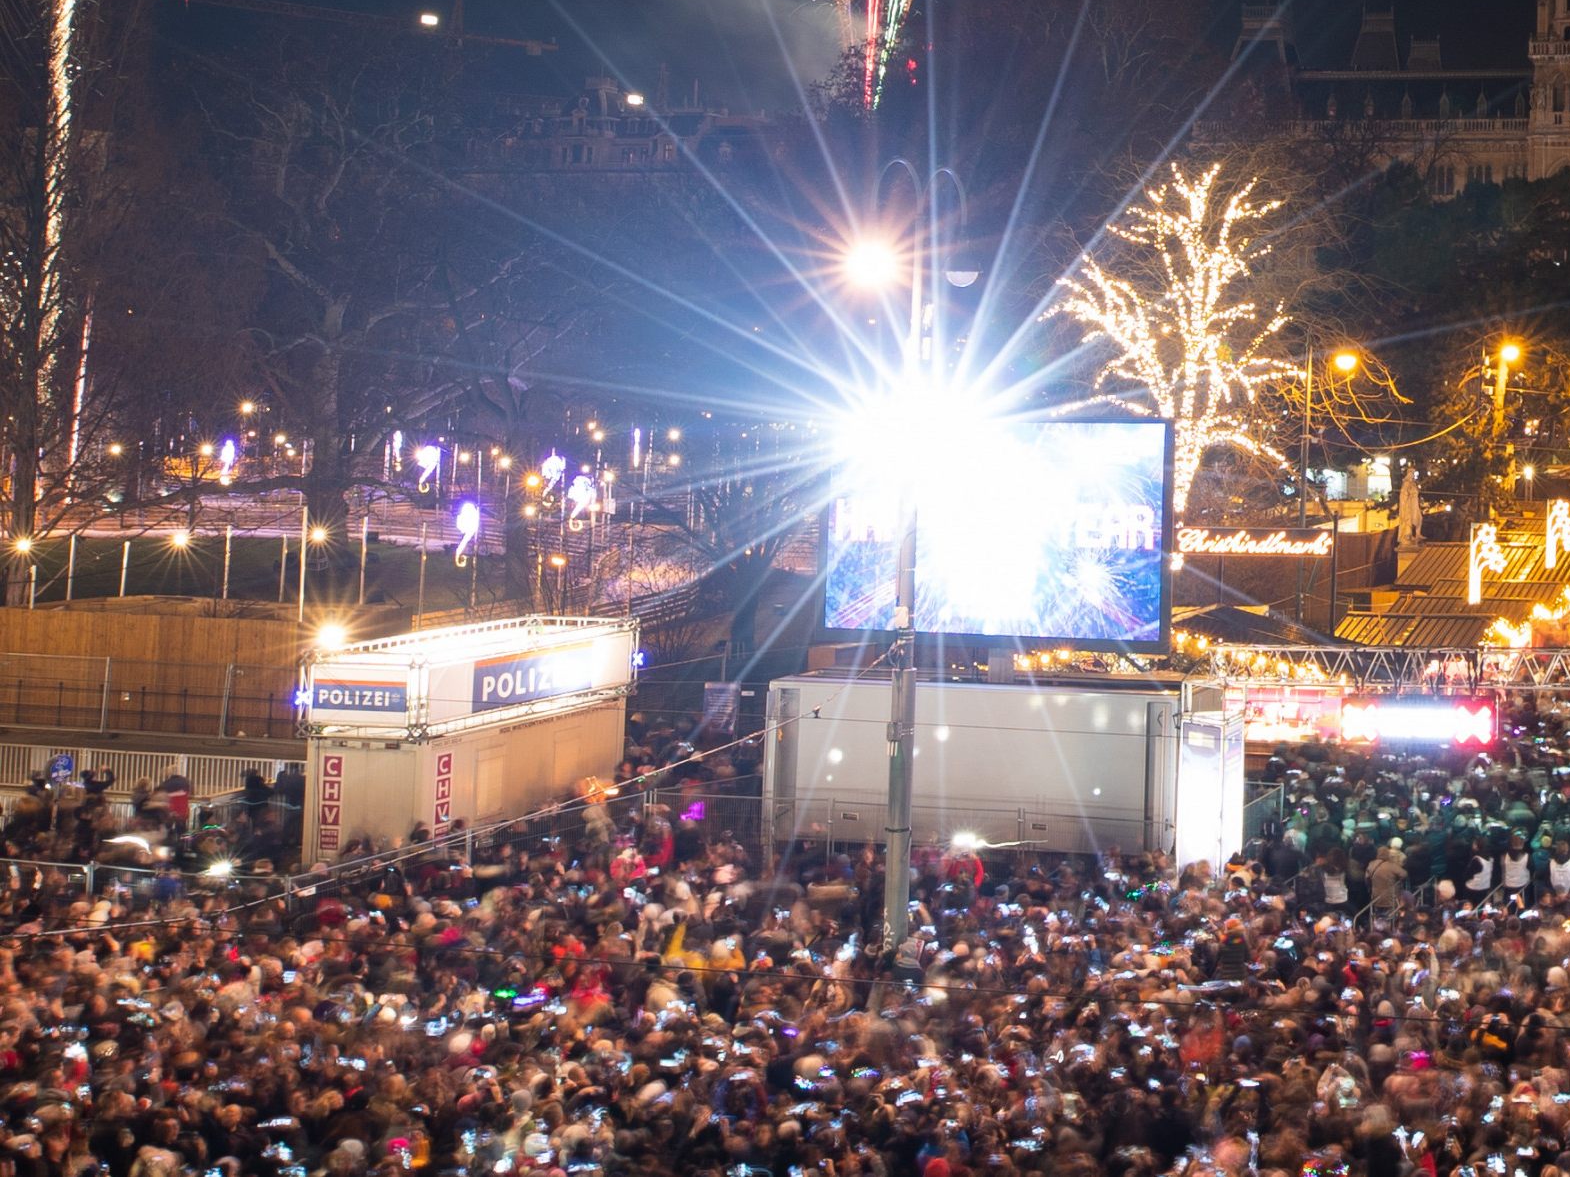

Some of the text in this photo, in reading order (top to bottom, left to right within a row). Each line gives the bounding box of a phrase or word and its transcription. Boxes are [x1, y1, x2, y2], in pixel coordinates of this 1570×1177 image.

[1177, 528, 1332, 555] Christkindlmarkt
[318, 689, 390, 707] POLIZEI
[324, 758, 339, 824] CHV
